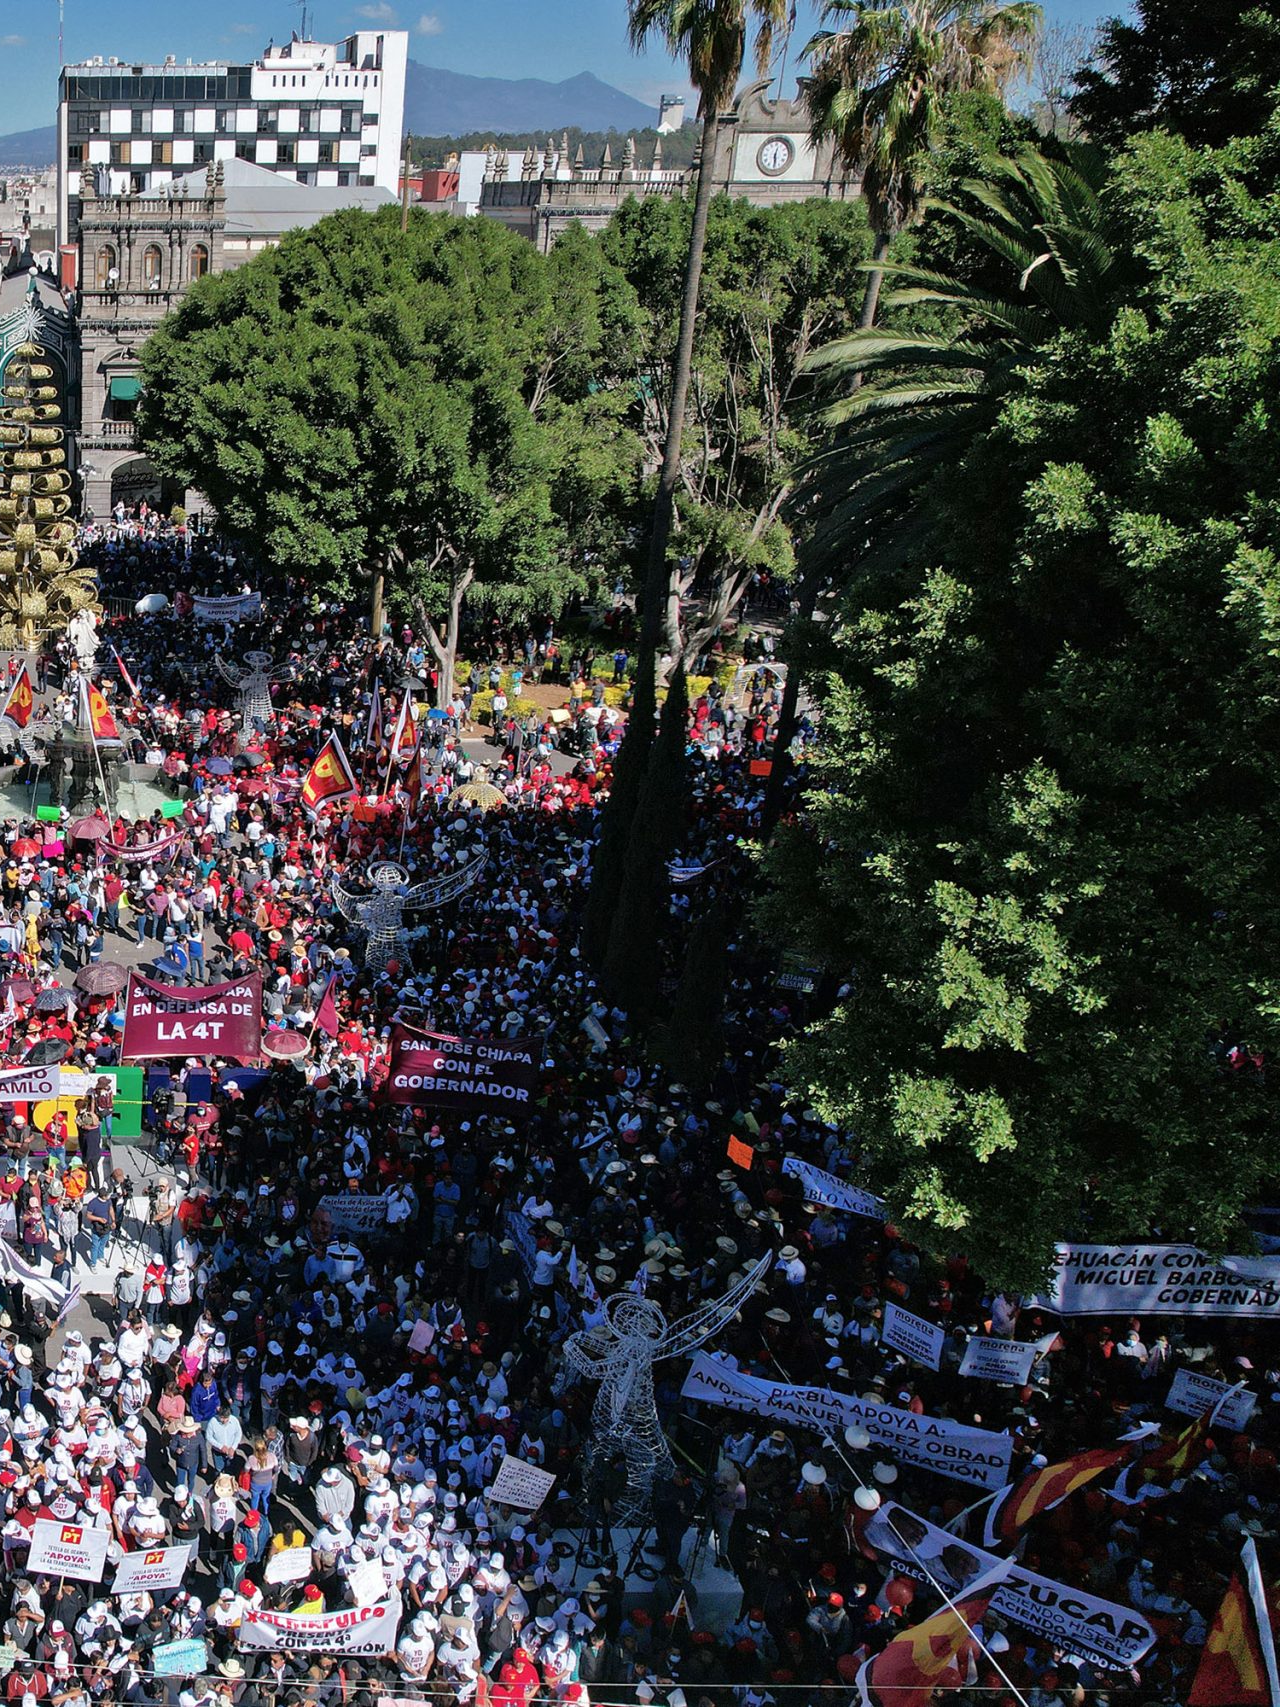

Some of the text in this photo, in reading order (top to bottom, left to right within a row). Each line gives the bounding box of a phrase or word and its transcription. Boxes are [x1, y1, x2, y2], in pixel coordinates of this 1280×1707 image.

[133, 1001, 253, 1016] EN DEFENSA DE
[157, 1022, 224, 1040] LA 4T
[400, 1039, 532, 1064] SAN JOSE CHIAPA
[433, 1058, 494, 1076] CON EL
[394, 1075, 529, 1102] GOBERNADOR
[1161, 1253, 1208, 1268] CON
[1074, 1269, 1158, 1286] MIGUEL
[894, 1310, 935, 1337] morena
[979, 1341, 1025, 1353] morena
[738, 1402, 761, 1417] LA
[849, 1403, 920, 1433] APOYA
[924, 1423, 947, 1439] A:
[766, 1396, 849, 1428] MANUEL
[925, 1441, 1004, 1468] OBRAD
[54, 1502, 69, 1510] SOY
[62, 1531, 81, 1543] PT
[145, 1553, 163, 1564] PT
[274, 1637, 307, 1648] CON
[312, 1637, 332, 1647] LA
